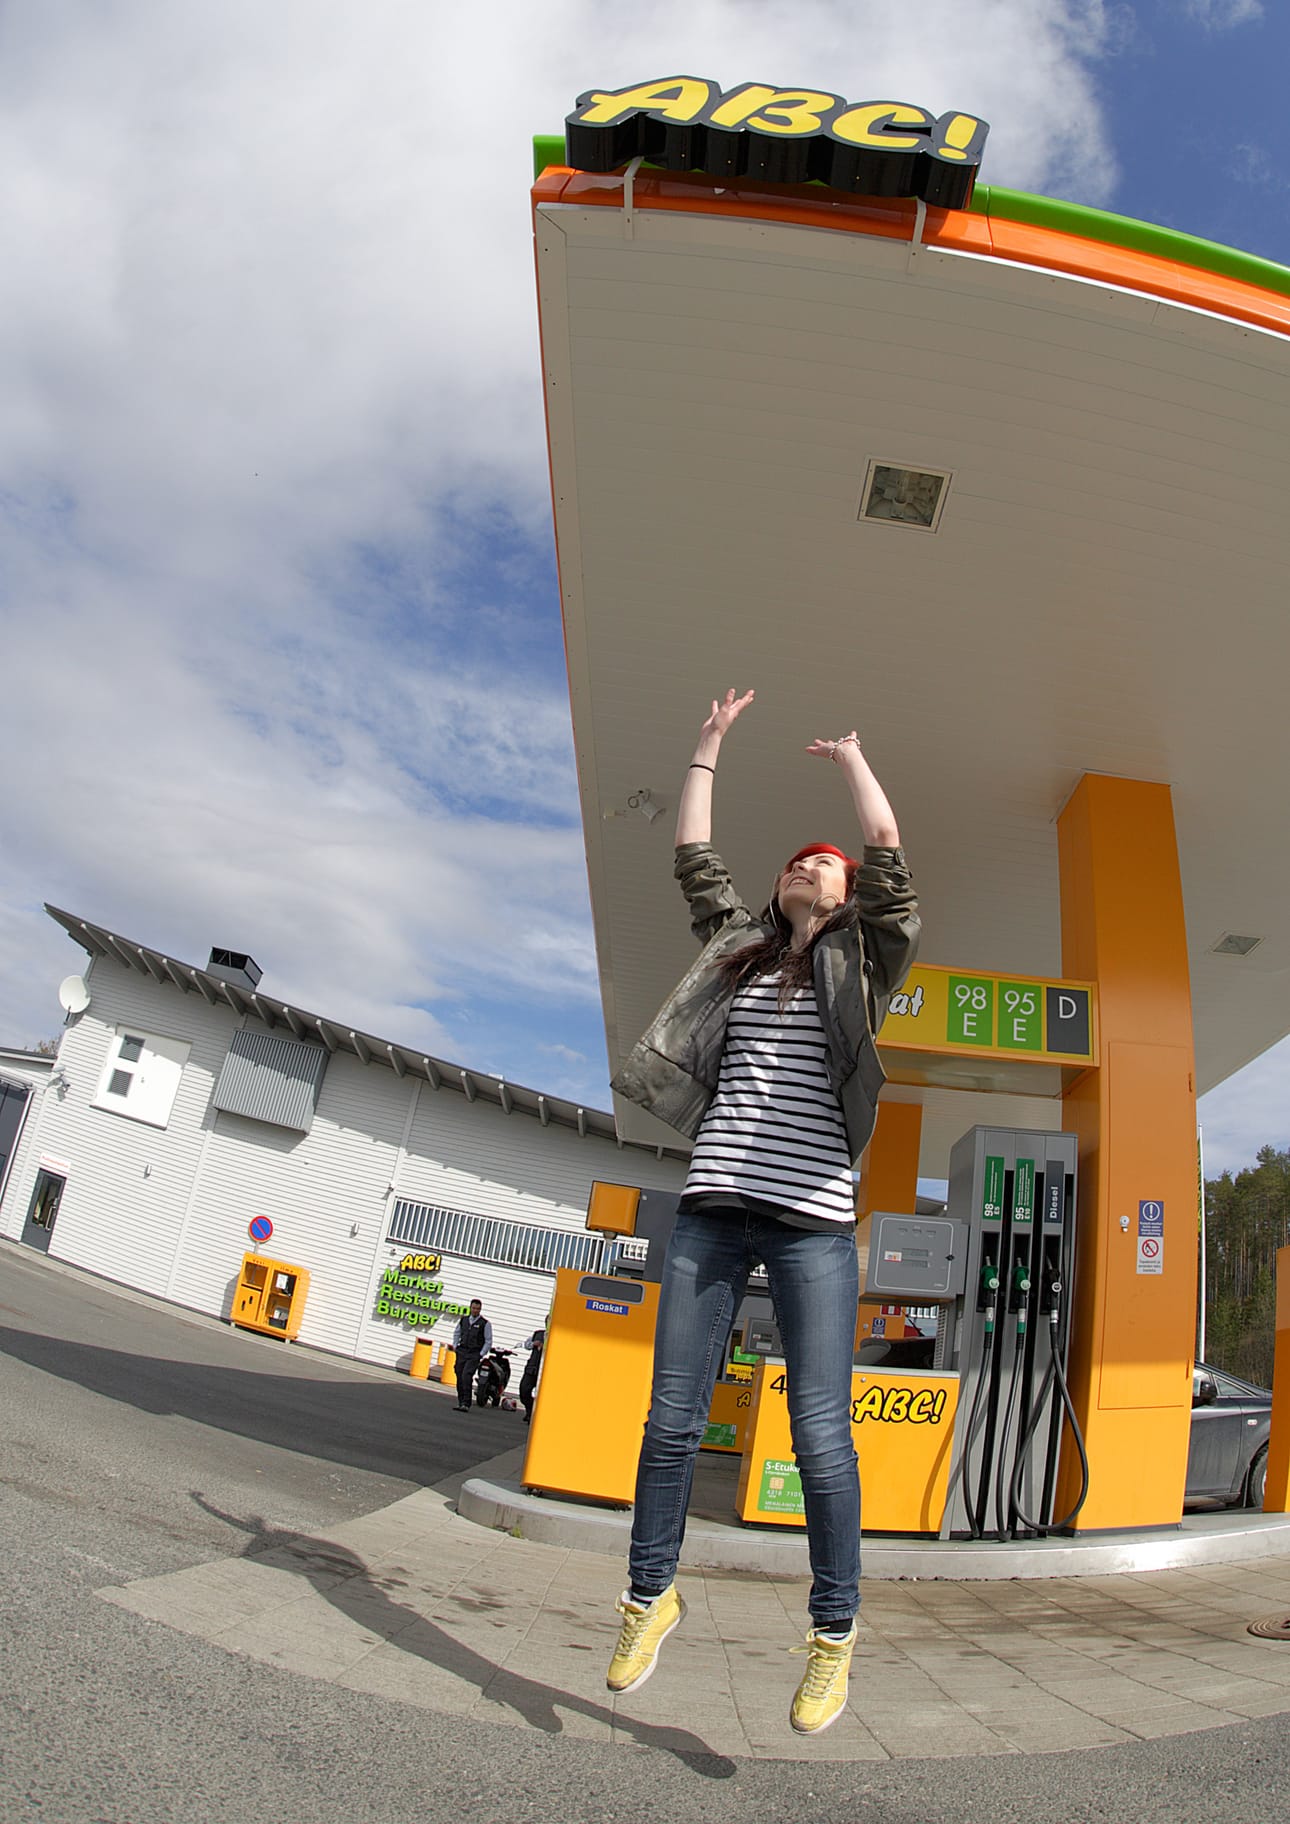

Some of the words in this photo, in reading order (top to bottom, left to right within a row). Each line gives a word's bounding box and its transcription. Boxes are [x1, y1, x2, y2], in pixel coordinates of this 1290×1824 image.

[574, 76, 983, 163] ABC!
[954, 984, 988, 1011] 98
[1004, 990, 1036, 1016] 95
[1058, 995, 1077, 1019] D
[962, 1012, 977, 1037] E
[1012, 1018, 1027, 1042] E
[984, 1203, 994, 1217] 98
[1015, 1206, 1025, 1220] 95
[1049, 1186, 1059, 1219] Diesel
[400, 1253, 442, 1272] ABC!
[383, 1268, 444, 1294] Market
[380, 1283, 472, 1317] Restauran
[591, 1301, 623, 1313] Roskat
[376, 1300, 439, 1326] Burger
[769, 1374, 788, 1395] 4
[852, 1385, 947, 1424] ABC!
